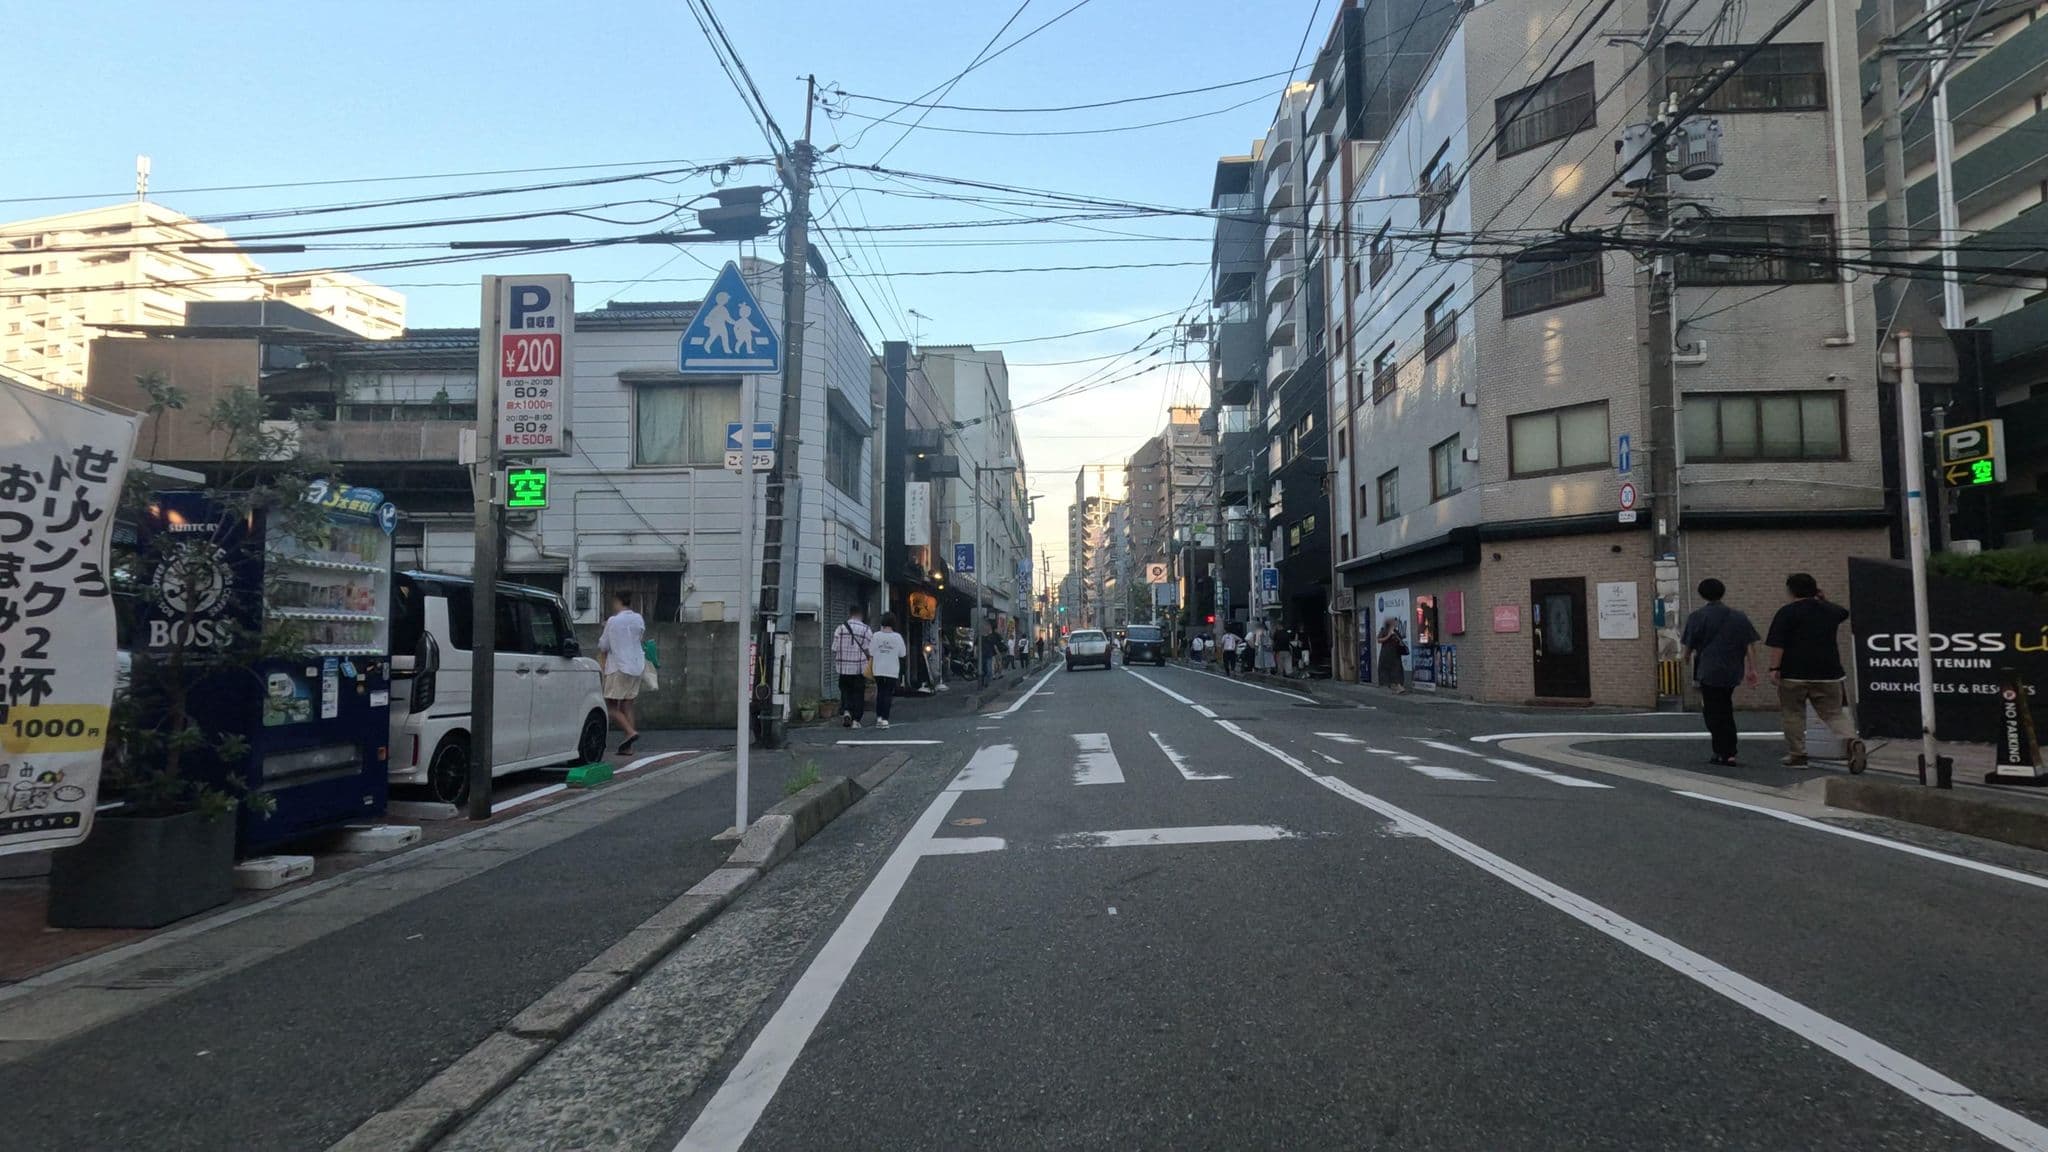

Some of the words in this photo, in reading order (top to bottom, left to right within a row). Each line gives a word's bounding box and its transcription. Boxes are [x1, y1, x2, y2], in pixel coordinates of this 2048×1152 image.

[509, 285, 551, 329] P
[506, 338, 555, 373] ¥200
[515, 387, 548, 398] 60分
[506, 400, 553, 410] 最大1000円
[514, 422, 548, 433] 60分
[505, 434, 553, 445] 最大500円
[1949, 430, 1981, 461] P
[1972, 459, 1993, 484] 空
[509, 469, 546, 506] 空
[149, 619, 234, 647] BOSS
[1867, 633, 2006, 652] CROSS
[1869, 658, 1922, 669] HAKAT
[1935, 658, 1992, 669] TENJIN
[1870, 682, 1901, 692] ORIX
[1904, 683, 1955, 694] HOELS
[1958, 684, 1969, 694] &
[2005, 702, 2017, 719] NO
[2006, 720, 2021, 763] PARKING
